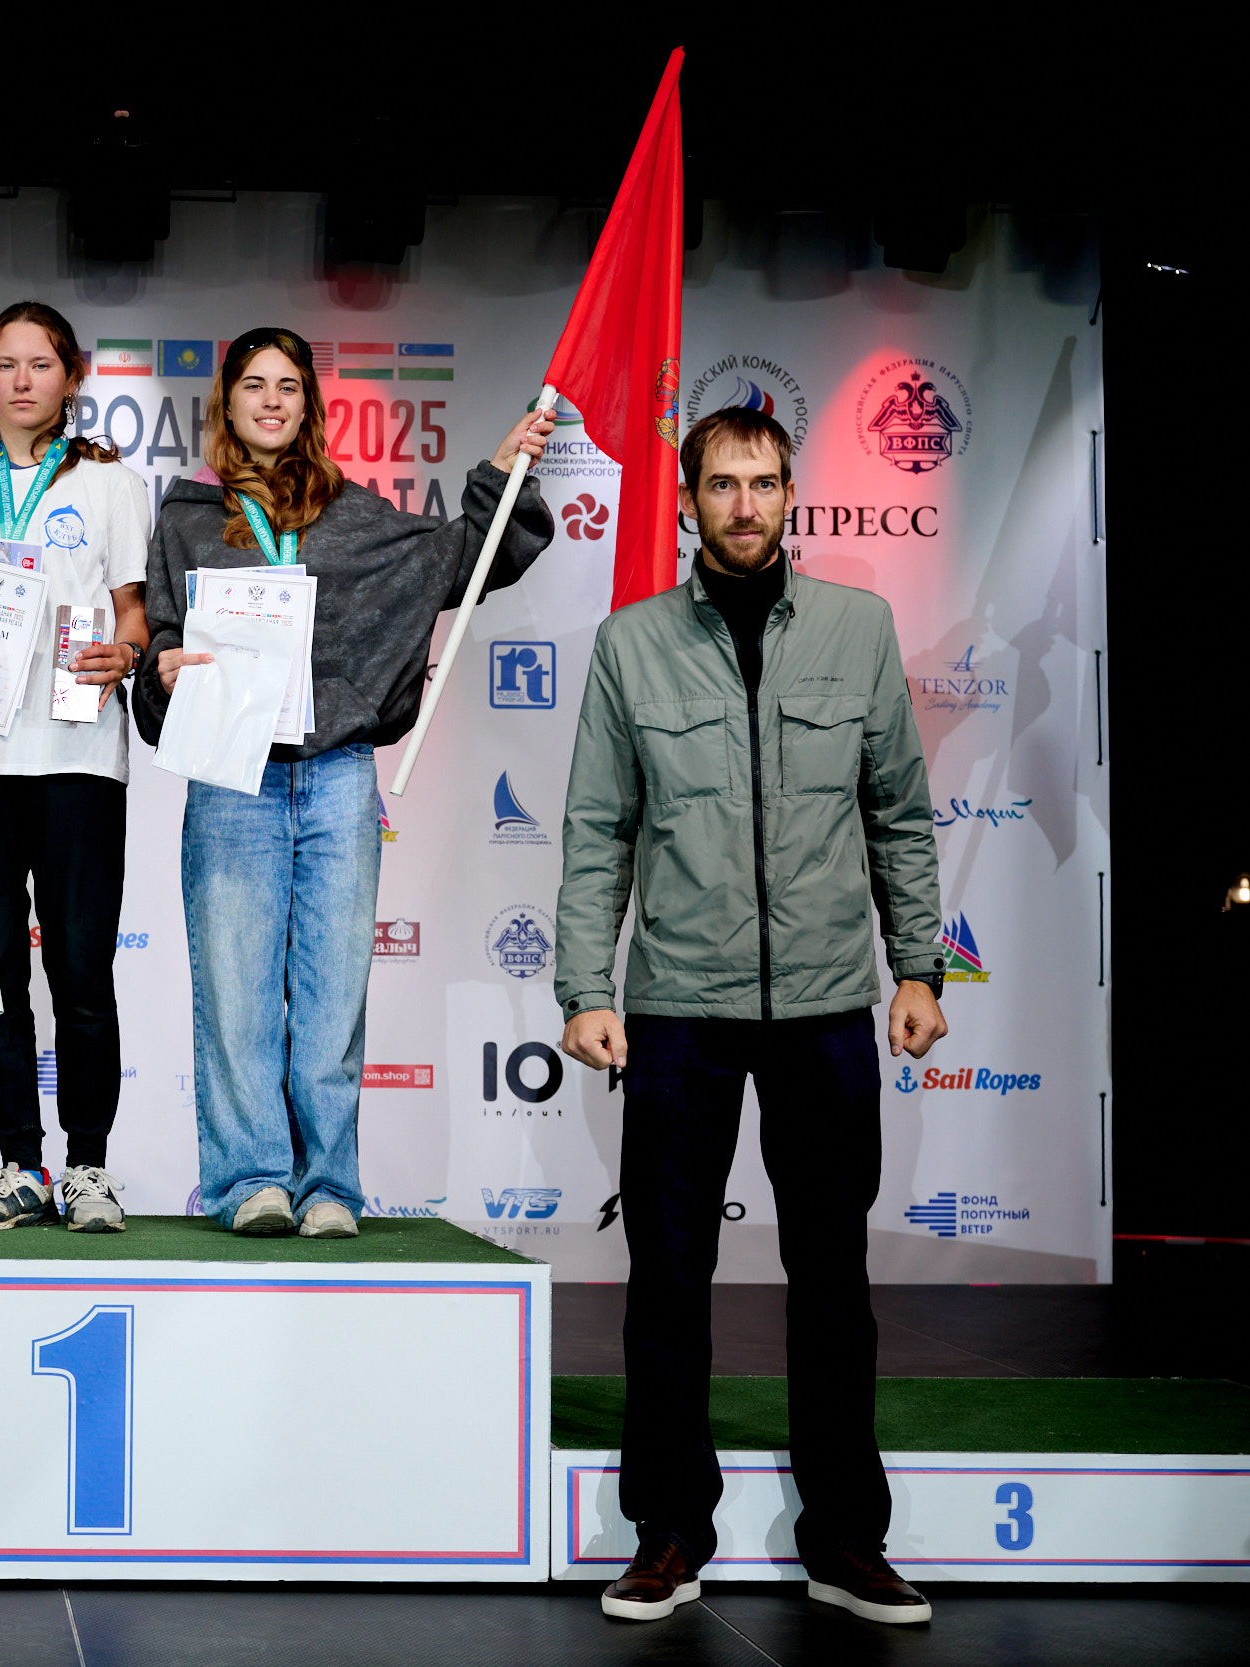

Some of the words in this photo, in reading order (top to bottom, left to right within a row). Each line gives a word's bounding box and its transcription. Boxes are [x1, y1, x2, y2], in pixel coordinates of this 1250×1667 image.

[742, 355, 801, 394] КОМИТЕТ
[880, 358, 935, 376] ФЕДЕРАЦИЯ
[939, 366, 972, 415] ПАРУСНОГО
[957, 420, 973, 456] СПОРТА
[329, 398, 446, 464] 2025
[891, 437, 941, 449] ВФПС
[527, 467, 615, 478] РАСНОДАРСКОГО
[918, 678, 1010, 695] TENZOR
[922, 1068, 973, 1090] Sail
[975, 1068, 1041, 1096] Ropes
[481, 1188, 562, 1219] VTS
[961, 1195, 998, 1206] ФОНД
[961, 1208, 1030, 1220] ПОПУТНЫЙ
[484, 1226, 560, 1236] VTSPORT.RU
[961, 1224, 993, 1234] ВЕТЕР
[32, 1305, 134, 1535] 1
[995, 1482, 1034, 1551] 3
